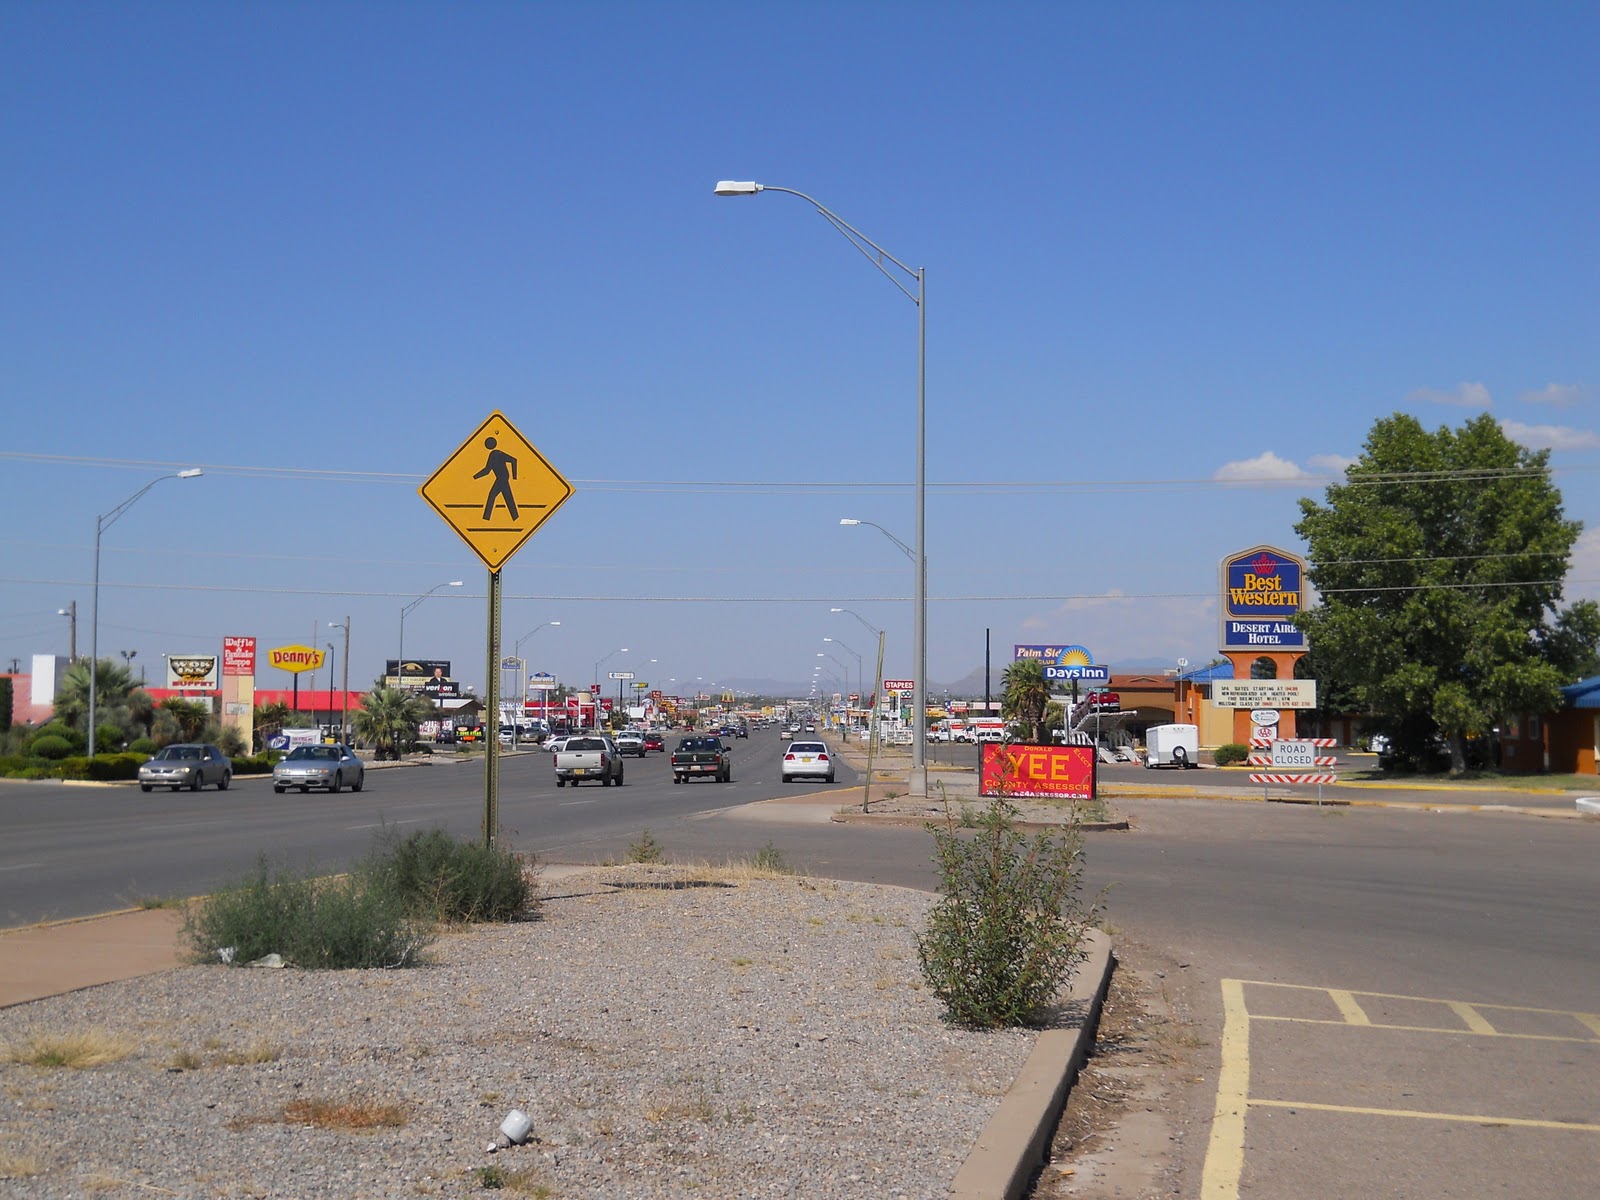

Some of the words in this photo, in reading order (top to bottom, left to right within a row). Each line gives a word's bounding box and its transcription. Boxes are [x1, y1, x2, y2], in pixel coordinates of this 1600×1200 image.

[1244, 574, 1281, 592] Best
[1230, 588, 1298, 606] Western
[1232, 622, 1270, 633] DESERT
[225, 638, 254, 648] Waffle
[1248, 634, 1280, 644] HOTEL
[224, 650, 254, 658] Pancake
[273, 651, 320, 665] Denny's
[1016, 648, 1042, 658] Palm
[1044, 648, 1062, 658] Sid
[225, 658, 251, 667] Shoppe
[1047, 668, 1080, 678] Days
[1082, 668, 1104, 678] Inn
[426, 684, 453, 692] verizon
[1280, 745, 1306, 753] ROAD
[984, 745, 1002, 764] ELEC
[1074, 748, 1092, 768] ELECT
[1275, 756, 1312, 764] CLOSED
[1006, 752, 1070, 780] YEE
[984, 780, 1028, 789] CONTY
[1034, 782, 1090, 791] ASSESSOR
